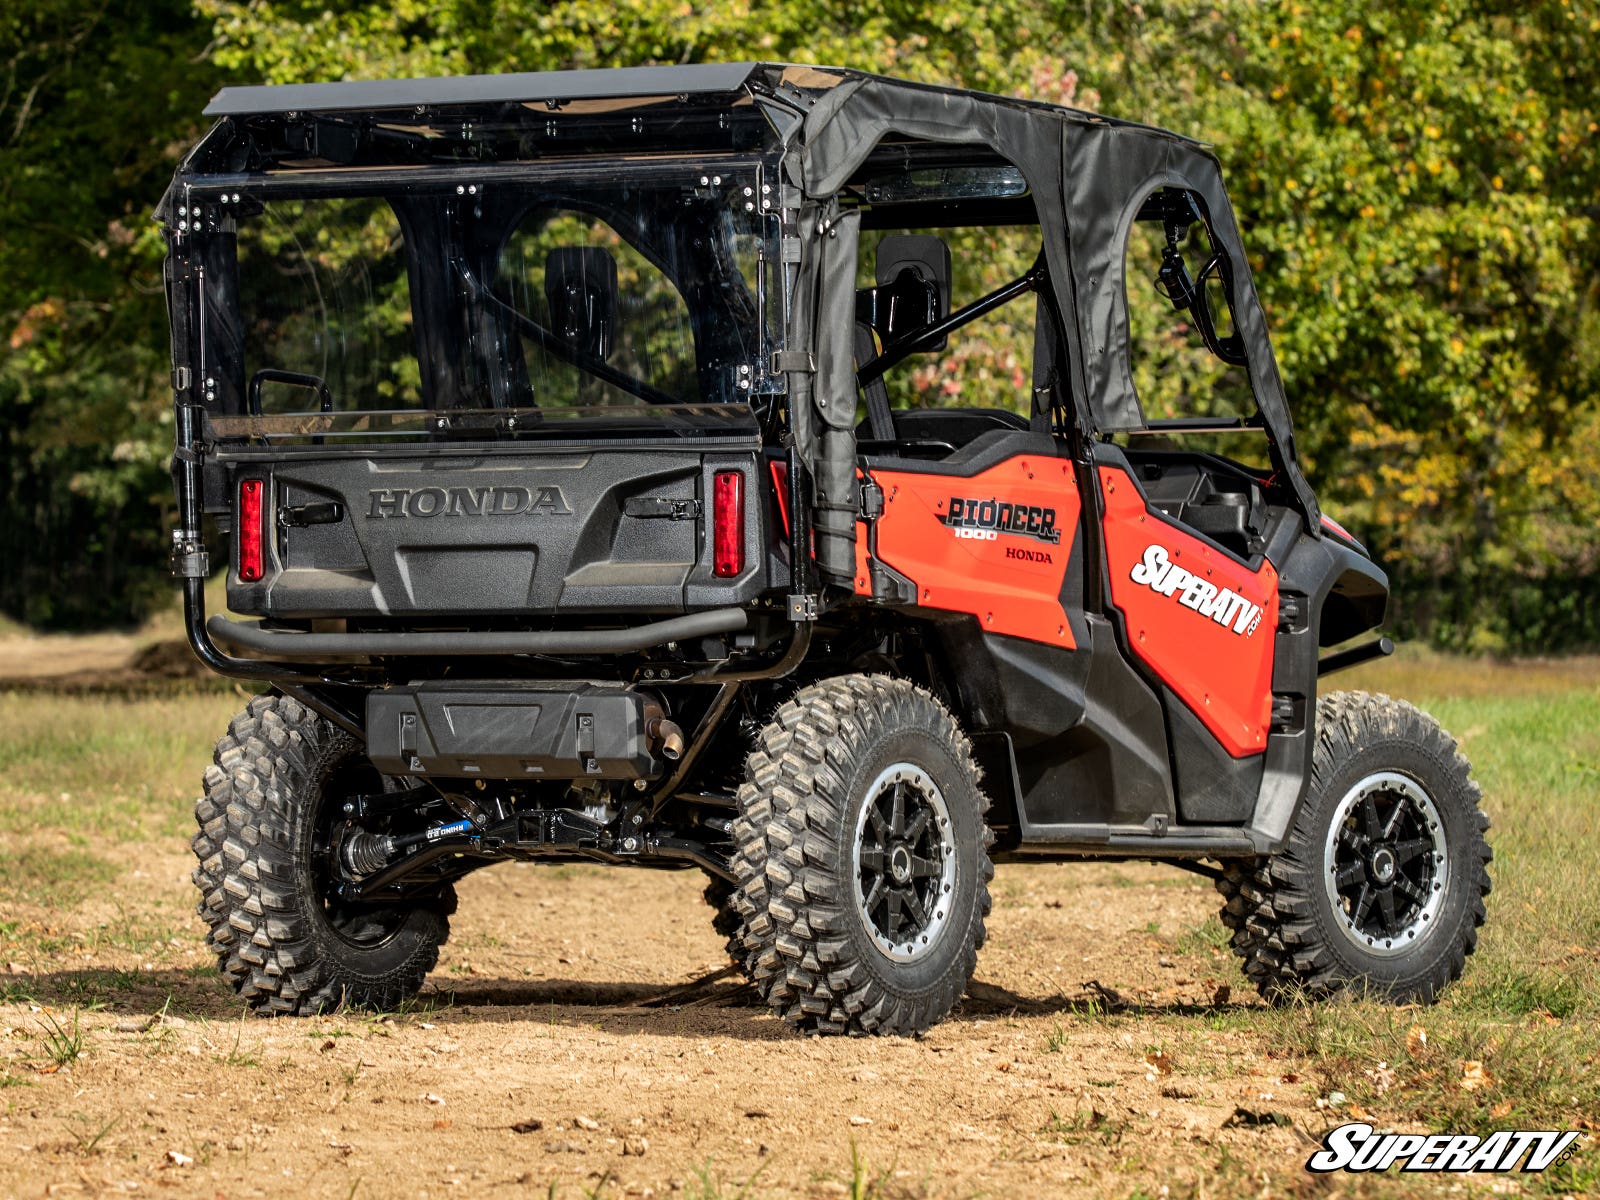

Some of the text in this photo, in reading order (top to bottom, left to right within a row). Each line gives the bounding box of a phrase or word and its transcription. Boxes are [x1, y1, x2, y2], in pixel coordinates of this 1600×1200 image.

[366, 486, 573, 519] HONDA
[946, 497, 1056, 536] PIONEER
[954, 528, 998, 541] 1000
[1006, 547, 1053, 564] HONDA
[440, 824, 464, 836] RHINO
